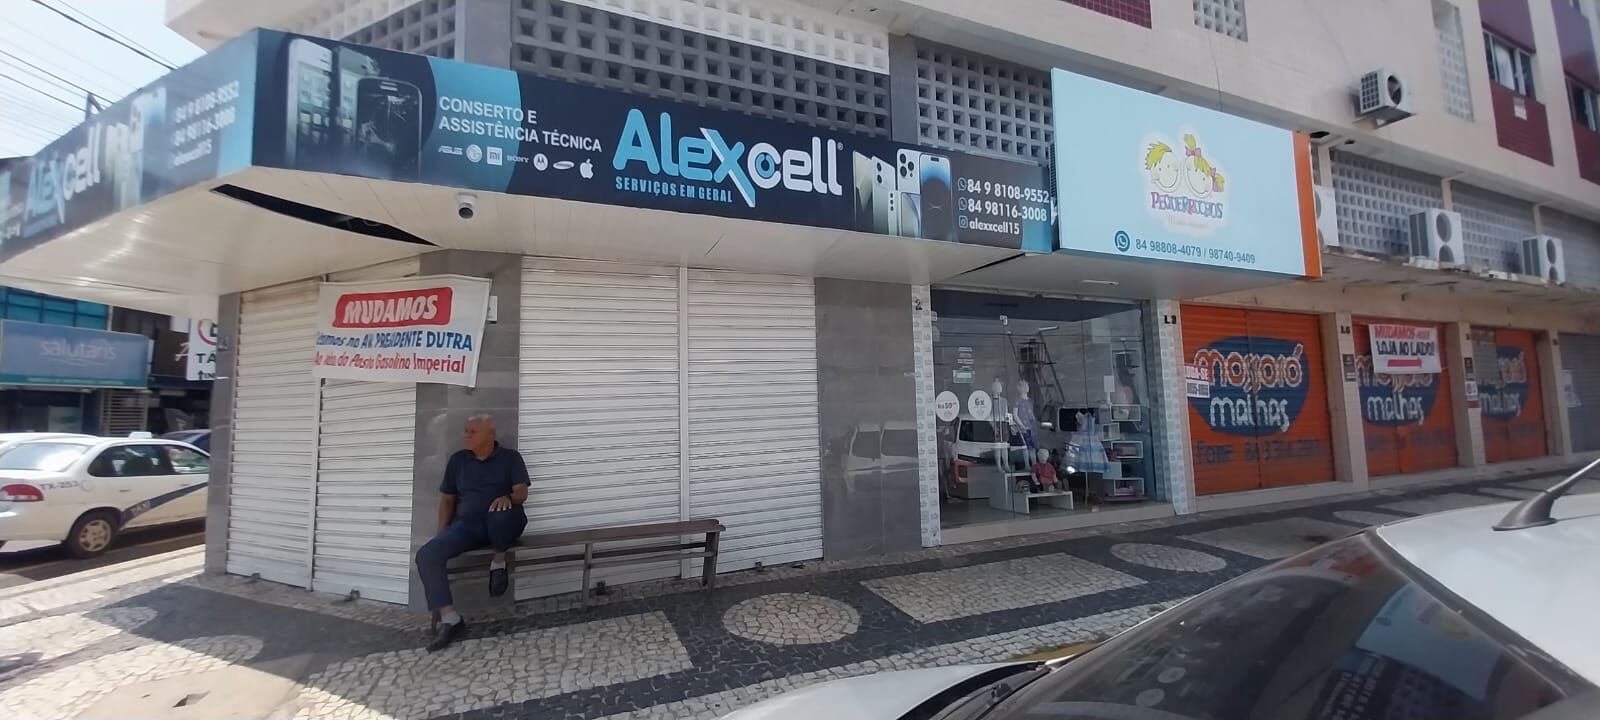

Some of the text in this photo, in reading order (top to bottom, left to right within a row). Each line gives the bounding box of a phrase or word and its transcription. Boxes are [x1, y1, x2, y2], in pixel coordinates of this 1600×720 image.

[439, 96, 537, 124] CONSERTO E
[438, 115, 603, 152] ASSISTÊNCIA TÉCNICA
[506, 154, 529, 163] SONY
[615, 175, 733, 204] SERVIÇOS EM GERAL
[967, 178, 1050, 204] 84 9 8108-9552
[967, 198, 1047, 222] 84 98116-3008
[969, 217, 1020, 235] alexxcell15
[1135, 238, 1147, 250] 84
[1149, 240, 1202, 257] 98808-4079
[1208, 248, 1256, 264] 98740-9409
[342, 294, 438, 325] MUDAMOS
[375, 330, 423, 349] PRESIDENTE
[426, 330, 473, 352] DUTRA
[1375, 340, 1398, 356] LOJA
[1399, 340, 1409, 356] AO
[413, 352, 466, 375] Imperial
[1209, 393, 1290, 433] malhas
[1366, 391, 1425, 426] malhas
